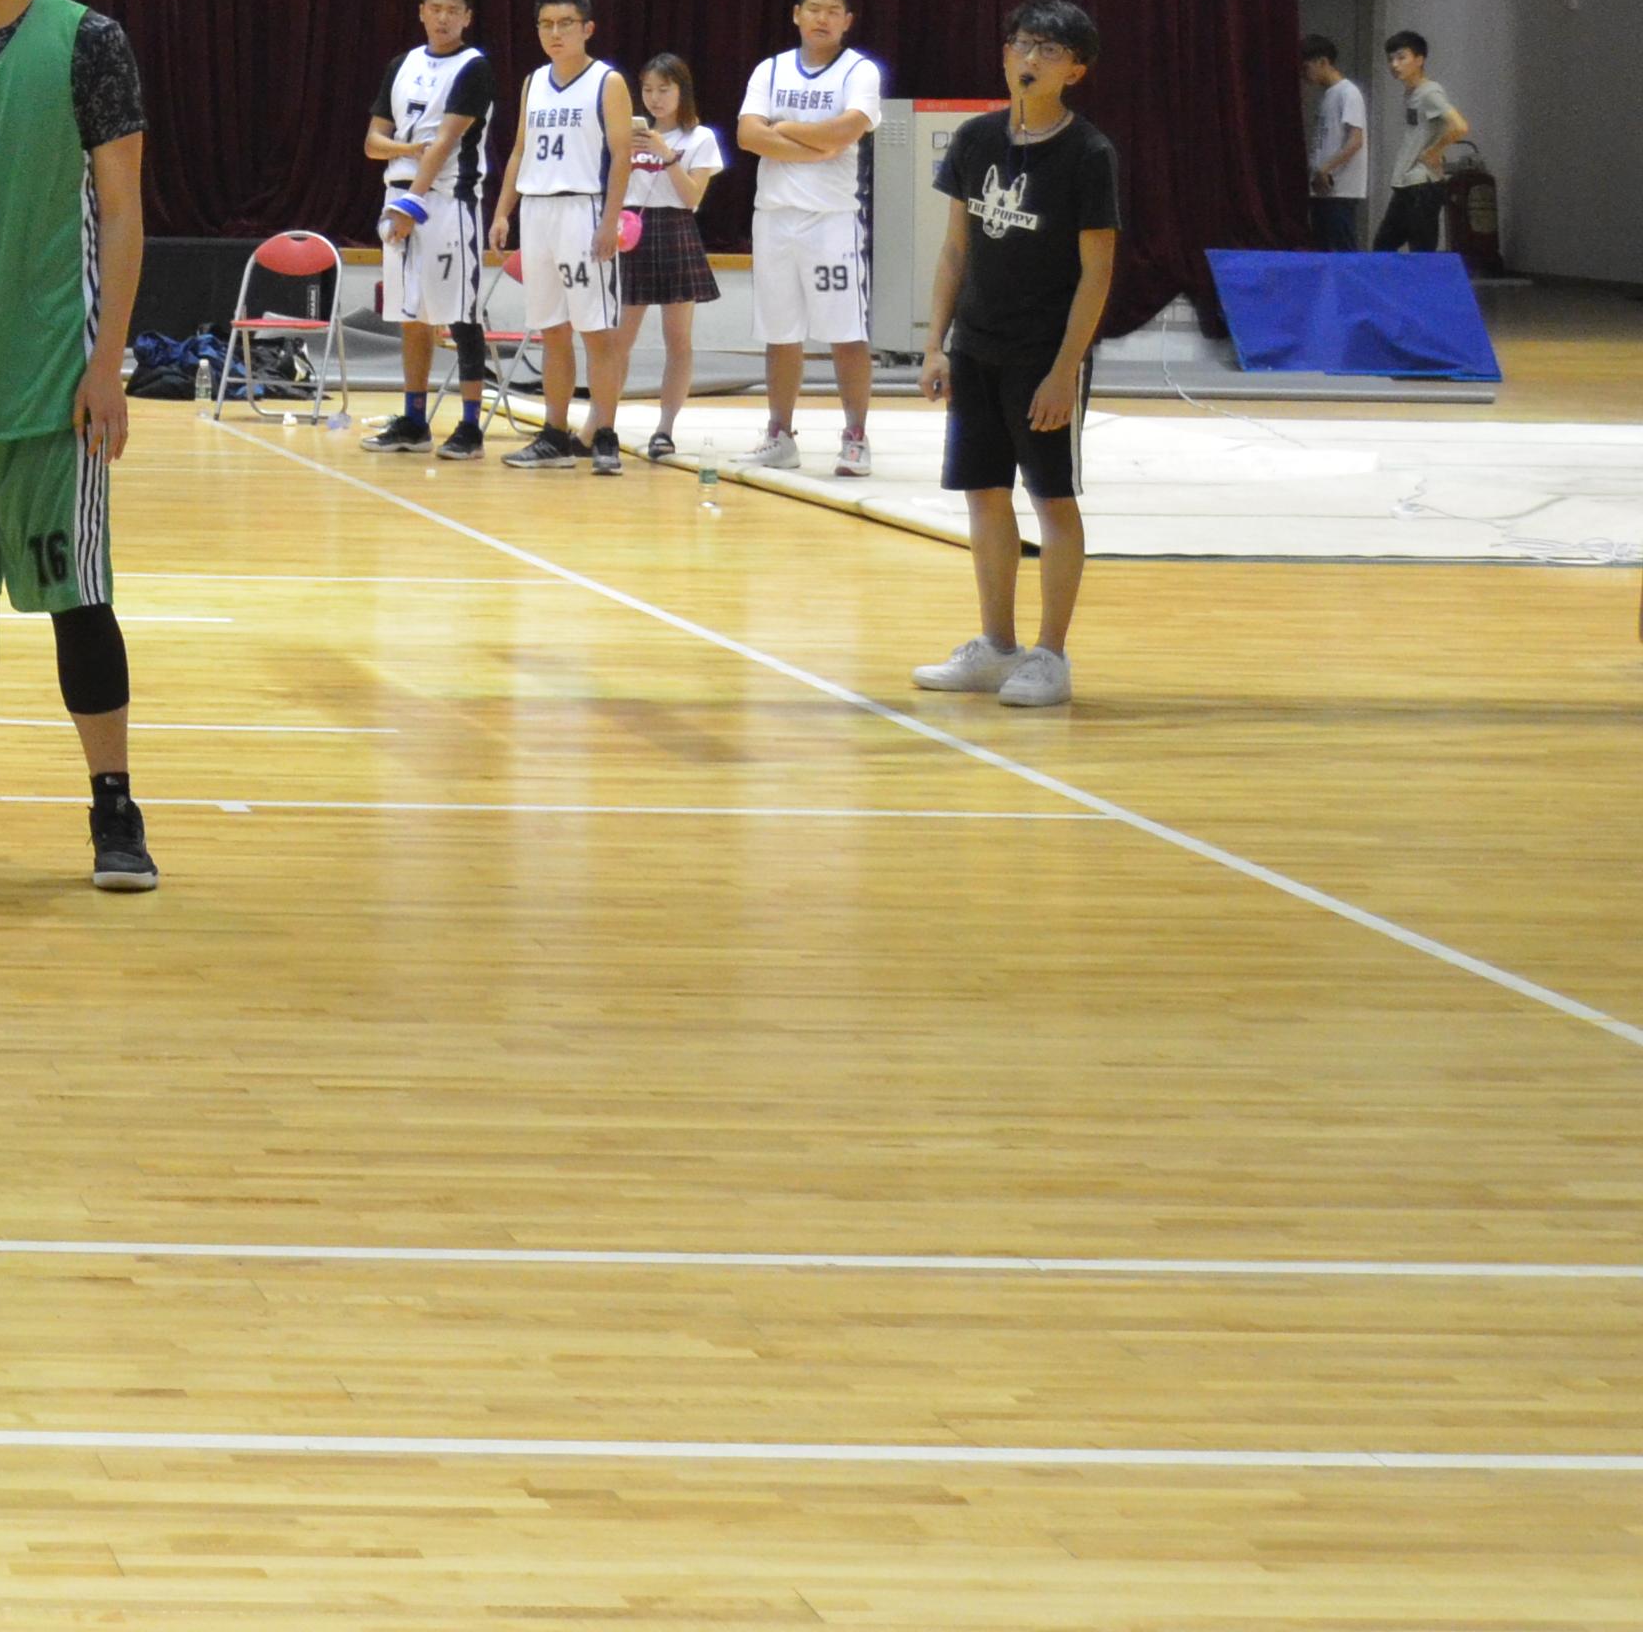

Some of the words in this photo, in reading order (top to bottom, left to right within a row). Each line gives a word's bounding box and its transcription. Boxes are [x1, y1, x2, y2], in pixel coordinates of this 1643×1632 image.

[536, 134, 564, 161] 34
[992, 207, 1034, 227] PUPPY
[437, 253, 453, 280] 7
[559, 261, 590, 289] 34
[815, 265, 848, 292] 39
[27, 529, 70, 587] 16
